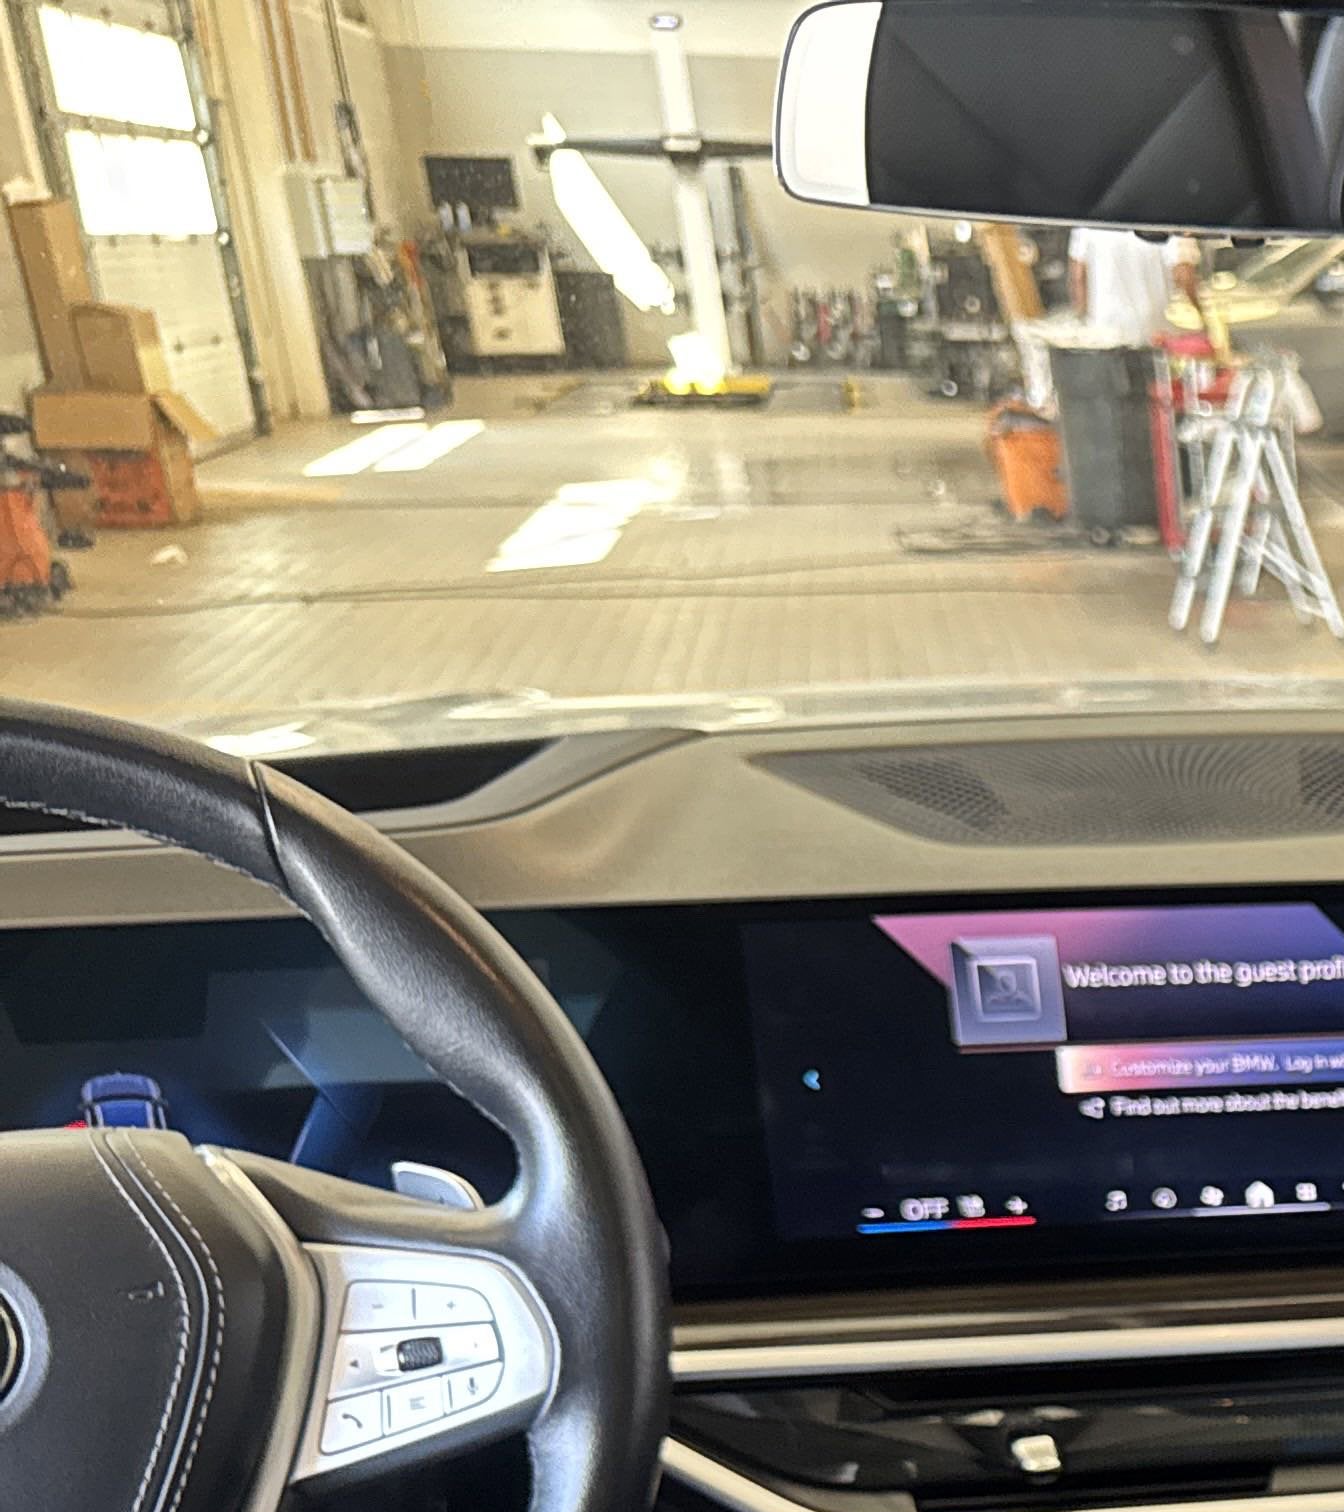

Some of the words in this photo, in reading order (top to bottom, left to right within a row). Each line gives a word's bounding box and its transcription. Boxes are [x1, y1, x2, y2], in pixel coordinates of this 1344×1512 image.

[1061, 963, 1166, 988] Welcome
[1167, 962, 1193, 985] to
[1193, 959, 1232, 984] the
[1233, 959, 1297, 987] guest
[1109, 1057, 1193, 1077] Customize
[1194, 1059, 1230, 1077] your
[1109, 1095, 1151, 1117] Find
[1151, 1096, 1181, 1115] out
[1181, 1095, 1224, 1114] more
[1224, 1092, 1272, 1113] about
[1272, 1090, 1299, 1110] the
[900, 1197, 949, 1221] OFF
